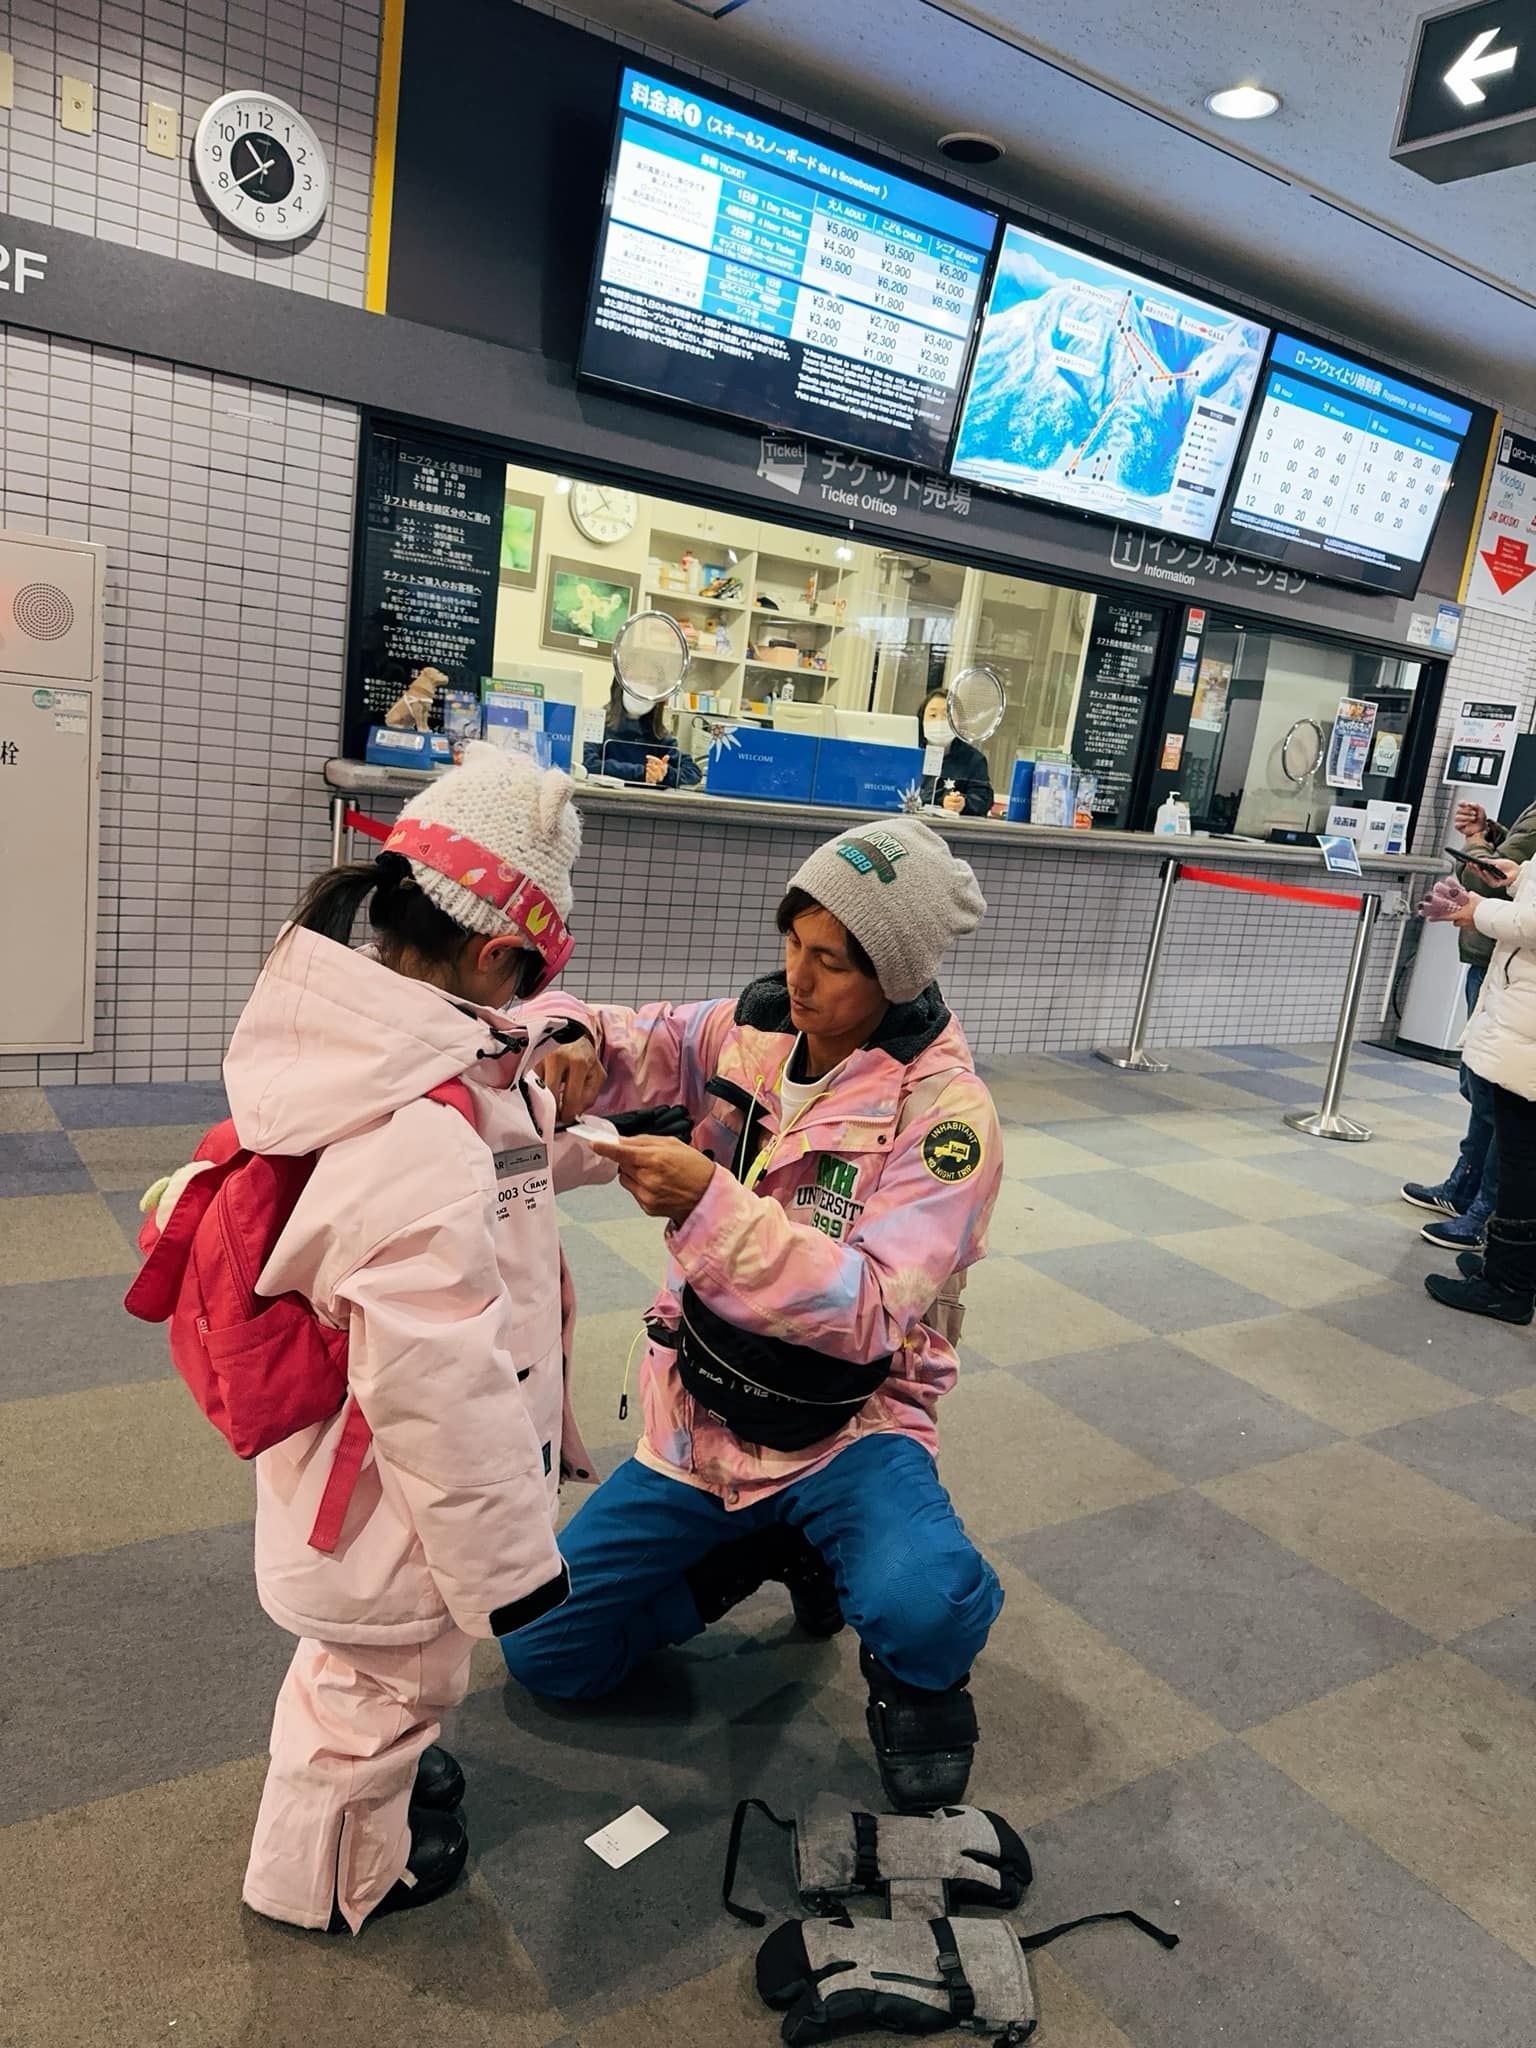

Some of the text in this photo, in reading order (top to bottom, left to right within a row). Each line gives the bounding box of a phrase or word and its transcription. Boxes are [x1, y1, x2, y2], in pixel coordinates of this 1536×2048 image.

[237, 110, 251, 129] 11
[258, 111, 274, 131] 12
[218, 122, 235, 142] 10
[284, 126, 291, 143] 1
[211, 145, 223, 162] 9
[296, 147, 307, 165] 2
[217, 171, 229, 189] 8
[719, 161, 747, 180] TICKET
[301, 174, 312, 191] 3
[234, 194, 244, 211] 7
[292, 196, 303, 212] 4
[254, 206, 265, 223] 6
[276, 207, 287, 224] 5
[843, 206, 868, 222] ADULT
[901, 229, 923, 243] CHILD
[1272, 405, 1353, 444] 8 40
[765, 442, 802, 459] Ticket
[1266, 429, 1347, 465] 9 00 20 40
[1258, 450, 1340, 486] 10 00 20 40
[1369, 440, 1441, 476] 13 00 20 40
[820, 450, 972, 516] チケット売場
[1362, 462, 1434, 496] 14 00 20 40
[820, 483, 898, 516] Ticket Office
[1251, 472, 1333, 507] 11 00 20 40
[1356, 483, 1428, 516] 15 00 20 40
[1245, 494, 1327, 529] 12 00 20 40
[1350, 504, 1404, 529] 16 00 20
[1144, 563, 1195, 586] Information
[1150, 536, 1307, 594] インフォメーション
[0, 741, 19, 766] 栓
[737, 752, 774, 763] WELCOME
[931, 1122, 977, 1144] INHABITANT
[498, 1187, 519, 1202] 003
